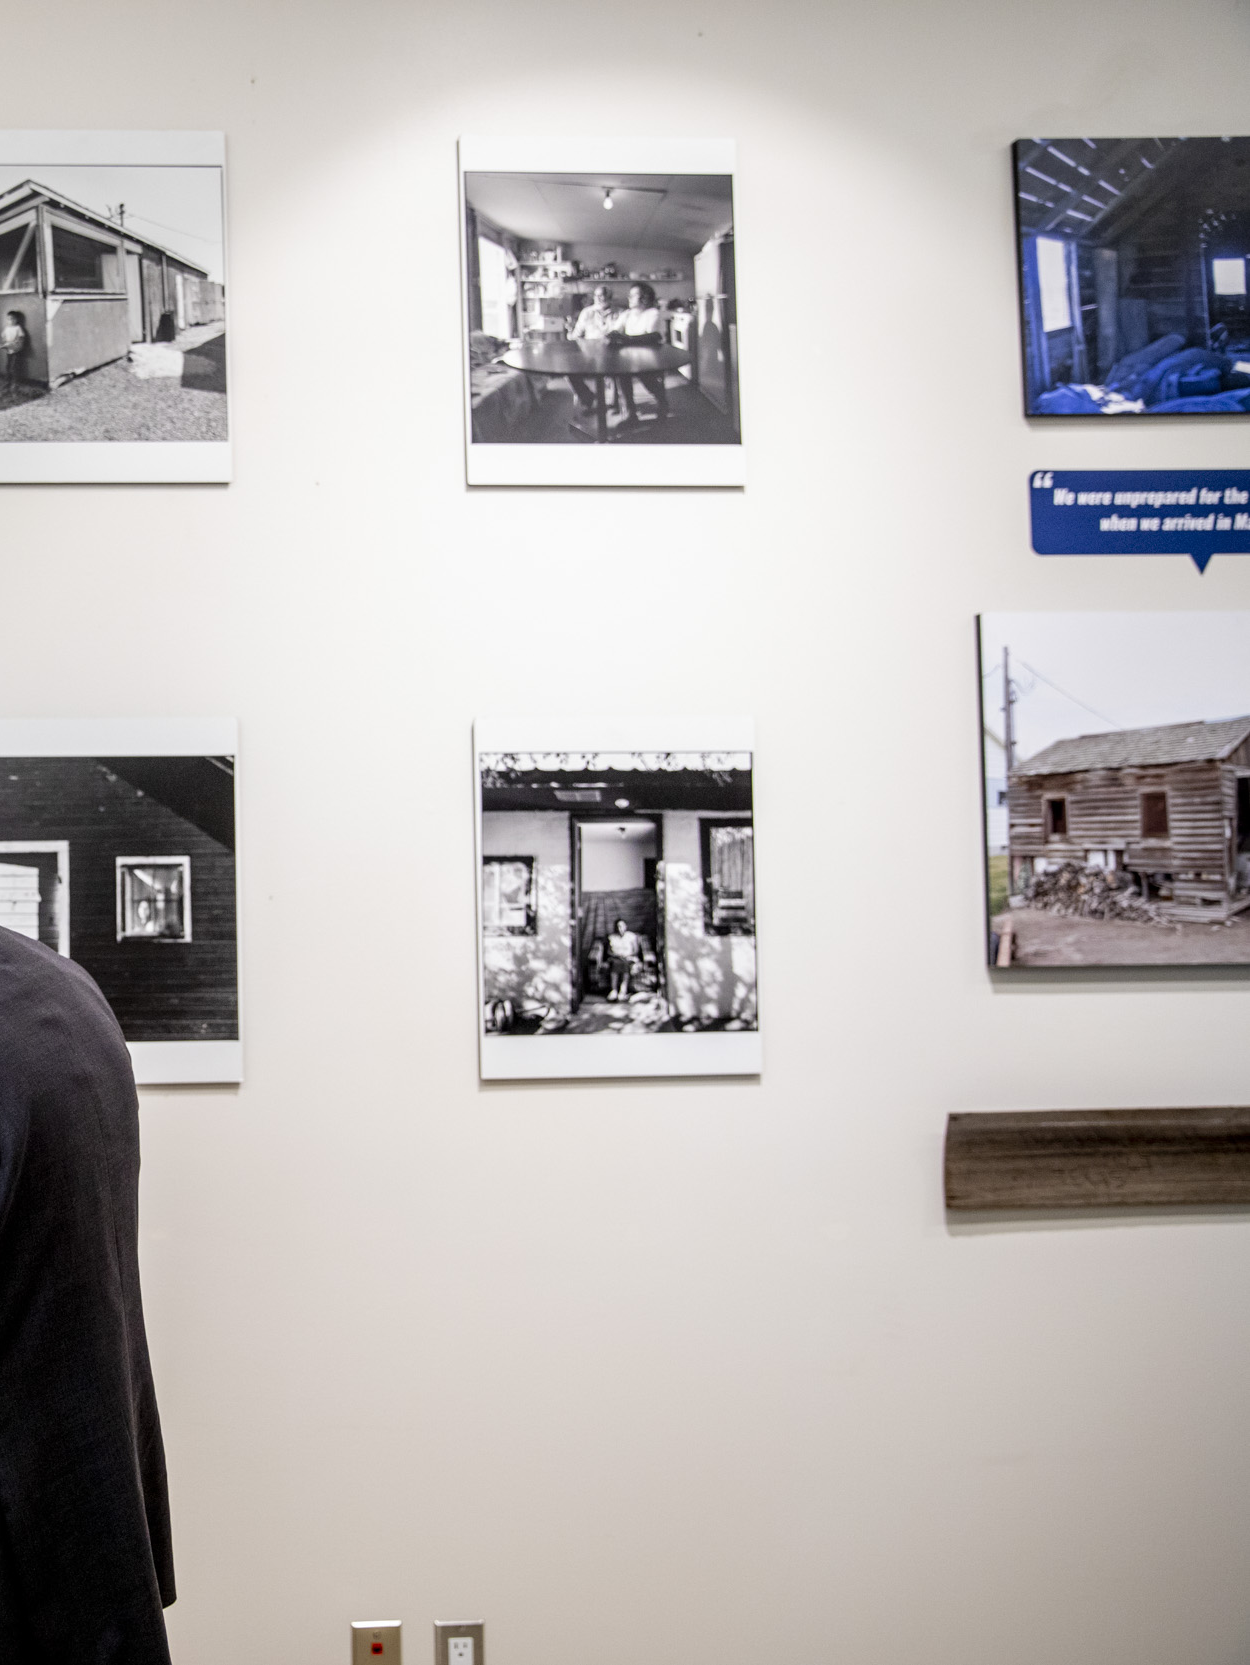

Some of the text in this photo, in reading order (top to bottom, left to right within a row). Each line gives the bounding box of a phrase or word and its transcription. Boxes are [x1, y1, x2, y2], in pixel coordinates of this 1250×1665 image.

[1053, 487, 1248, 508] We were unprepared for the
[1100, 514, 1138, 531] when
[1140, 516, 1160, 531] we
[1161, 514, 1214, 531] arrived
[1216, 513, 1232, 530] in
